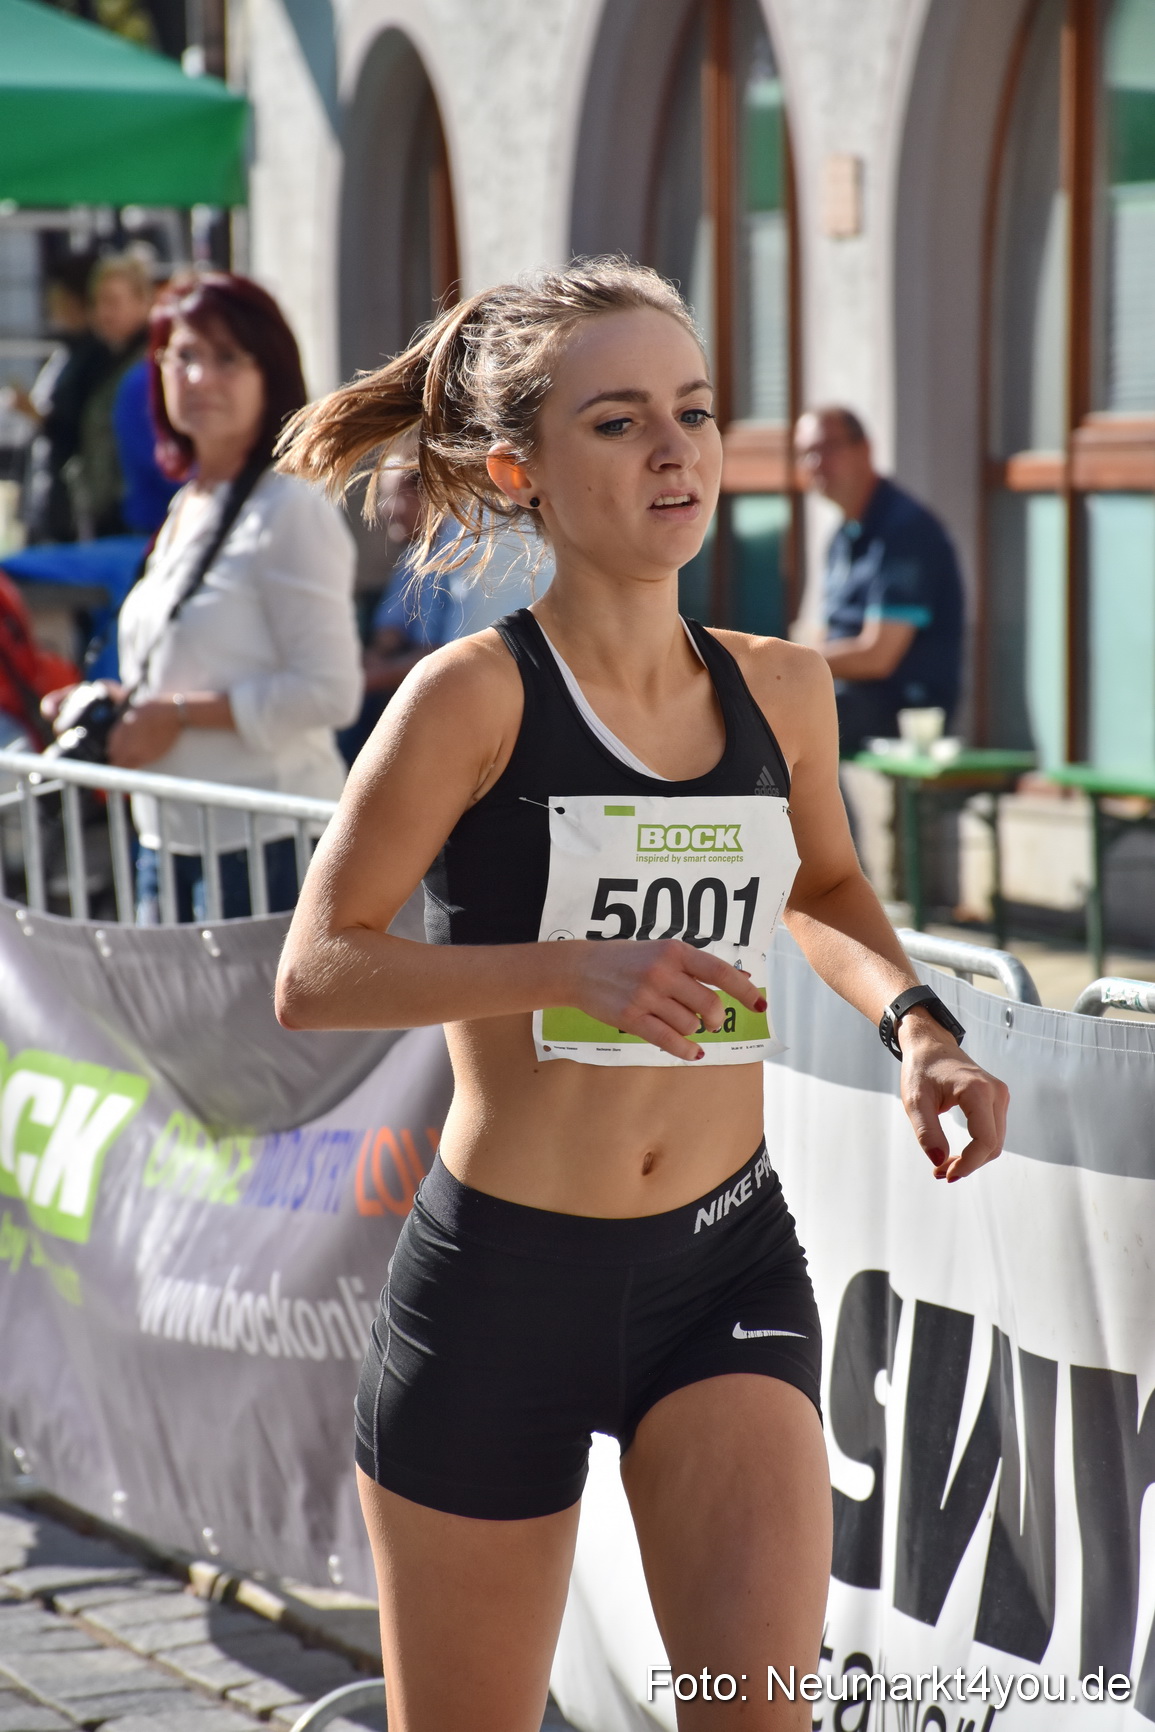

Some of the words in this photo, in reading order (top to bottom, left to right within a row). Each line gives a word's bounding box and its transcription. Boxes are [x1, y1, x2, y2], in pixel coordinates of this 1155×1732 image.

[754, 785, 780, 797] adidas
[636, 854, 669, 864] inspired
[671, 854, 681, 864] by
[683, 854, 706, 863] smart
[708, 854, 744, 864] concepts
[637, 824, 743, 852] BOCK
[586, 877, 760, 948] 5001
[0, 1066, 137, 1220] CK
[693, 1170, 753, 1235] NIKE
[755, 1148, 773, 1189] PR
[140, 1264, 382, 1363] www.bockonli
